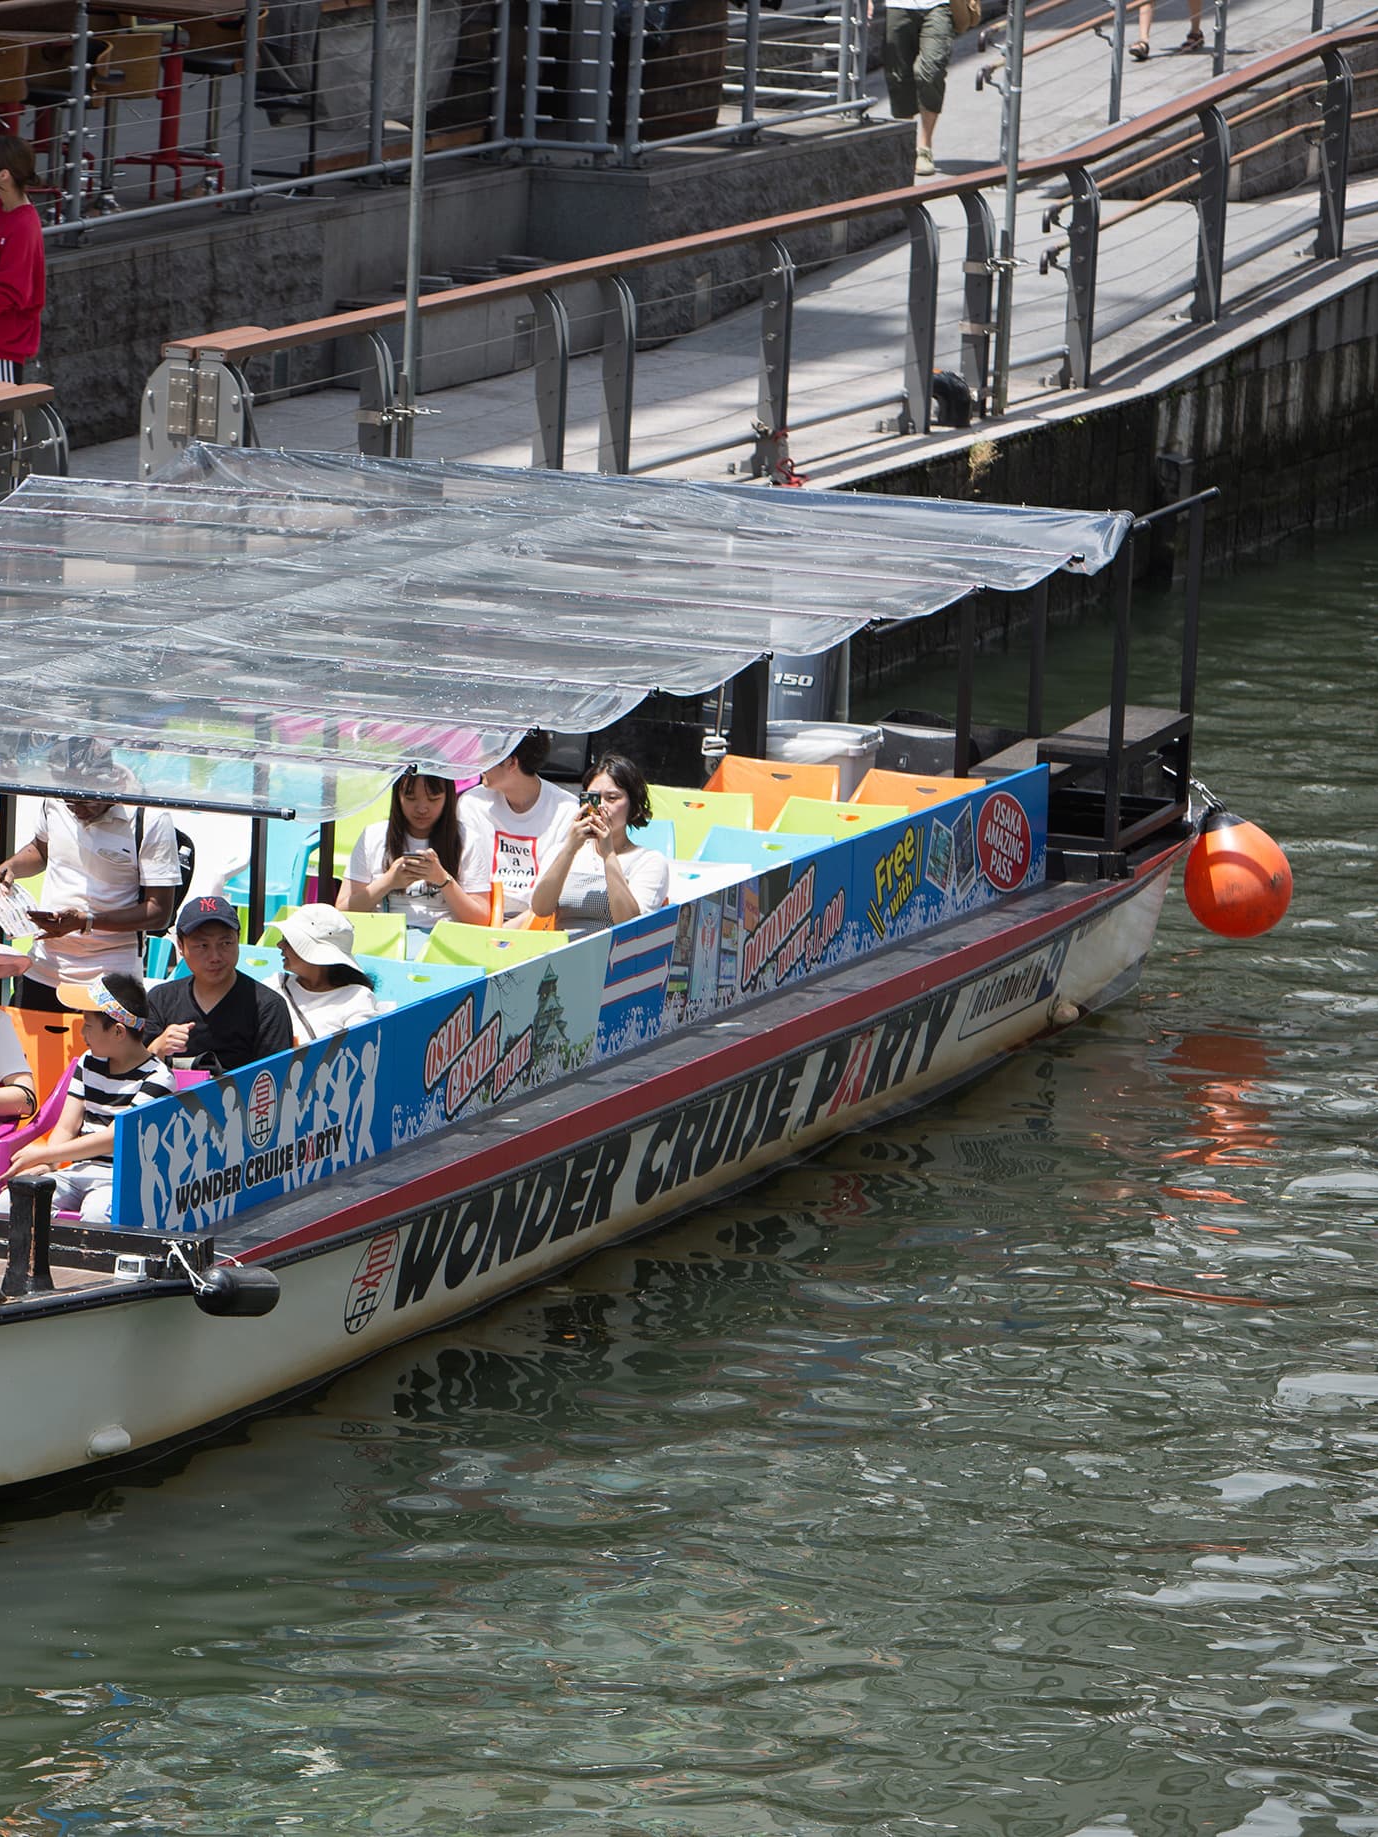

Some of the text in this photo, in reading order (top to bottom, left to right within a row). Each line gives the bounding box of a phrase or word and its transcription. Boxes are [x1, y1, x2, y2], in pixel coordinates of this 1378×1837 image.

[773, 672, 814, 688] 150
[500, 839, 530, 856] have
[984, 820, 1024, 865] AMAZING
[993, 799, 1022, 836] OSAKA
[512, 857, 520, 866] a
[874, 825, 915, 907] Free
[989, 850, 1014, 883] PASS
[742, 865, 814, 987] DOTONBORI
[889, 871, 913, 918] with
[777, 918, 811, 983] ROUTE
[424, 996, 472, 1090] OSAKA
[445, 1015, 500, 1116] CASTLE
[493, 1027, 532, 1100] ROUTE
[175, 1124, 342, 1215] WONDER CRUISE PARTY
[393, 988, 961, 1311] WONDER CRUISE PARTY
